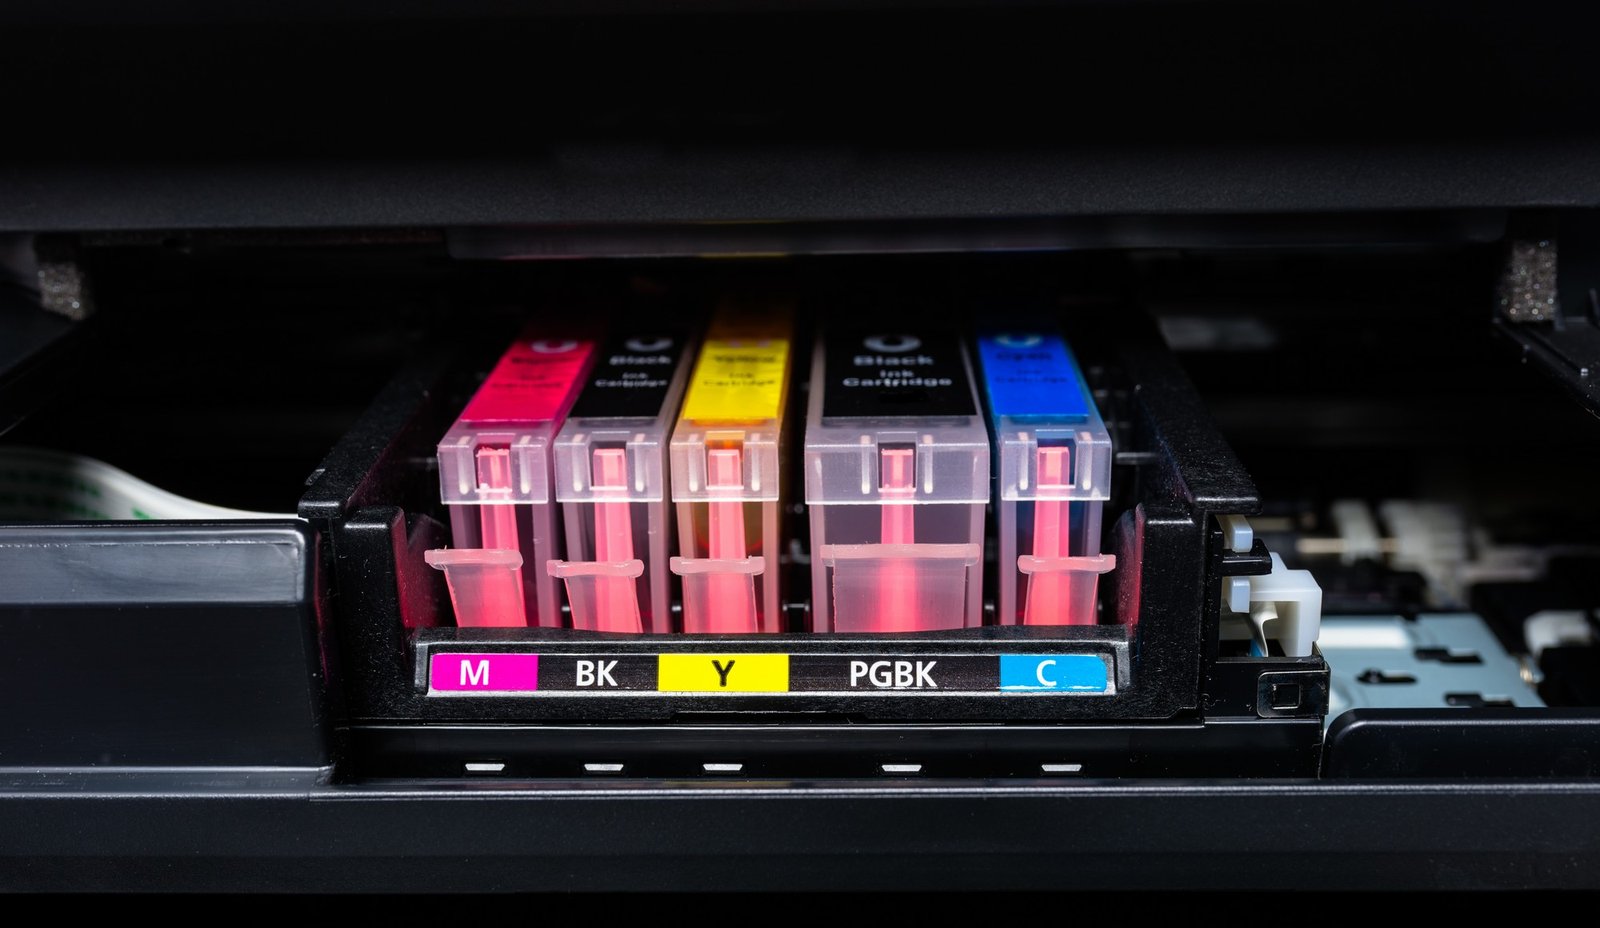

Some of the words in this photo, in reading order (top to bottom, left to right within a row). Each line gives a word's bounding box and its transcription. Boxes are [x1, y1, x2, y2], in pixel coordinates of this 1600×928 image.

[853, 355, 934, 366] Black
[880, 370, 914, 379] Ink
[842, 377, 953, 388] Cartridge
[459, 660, 490, 686] M
[576, 660, 618, 686] BK
[711, 660, 736, 687] Y
[850, 661, 937, 687] PGBK
[1036, 660, 1057, 686] C
